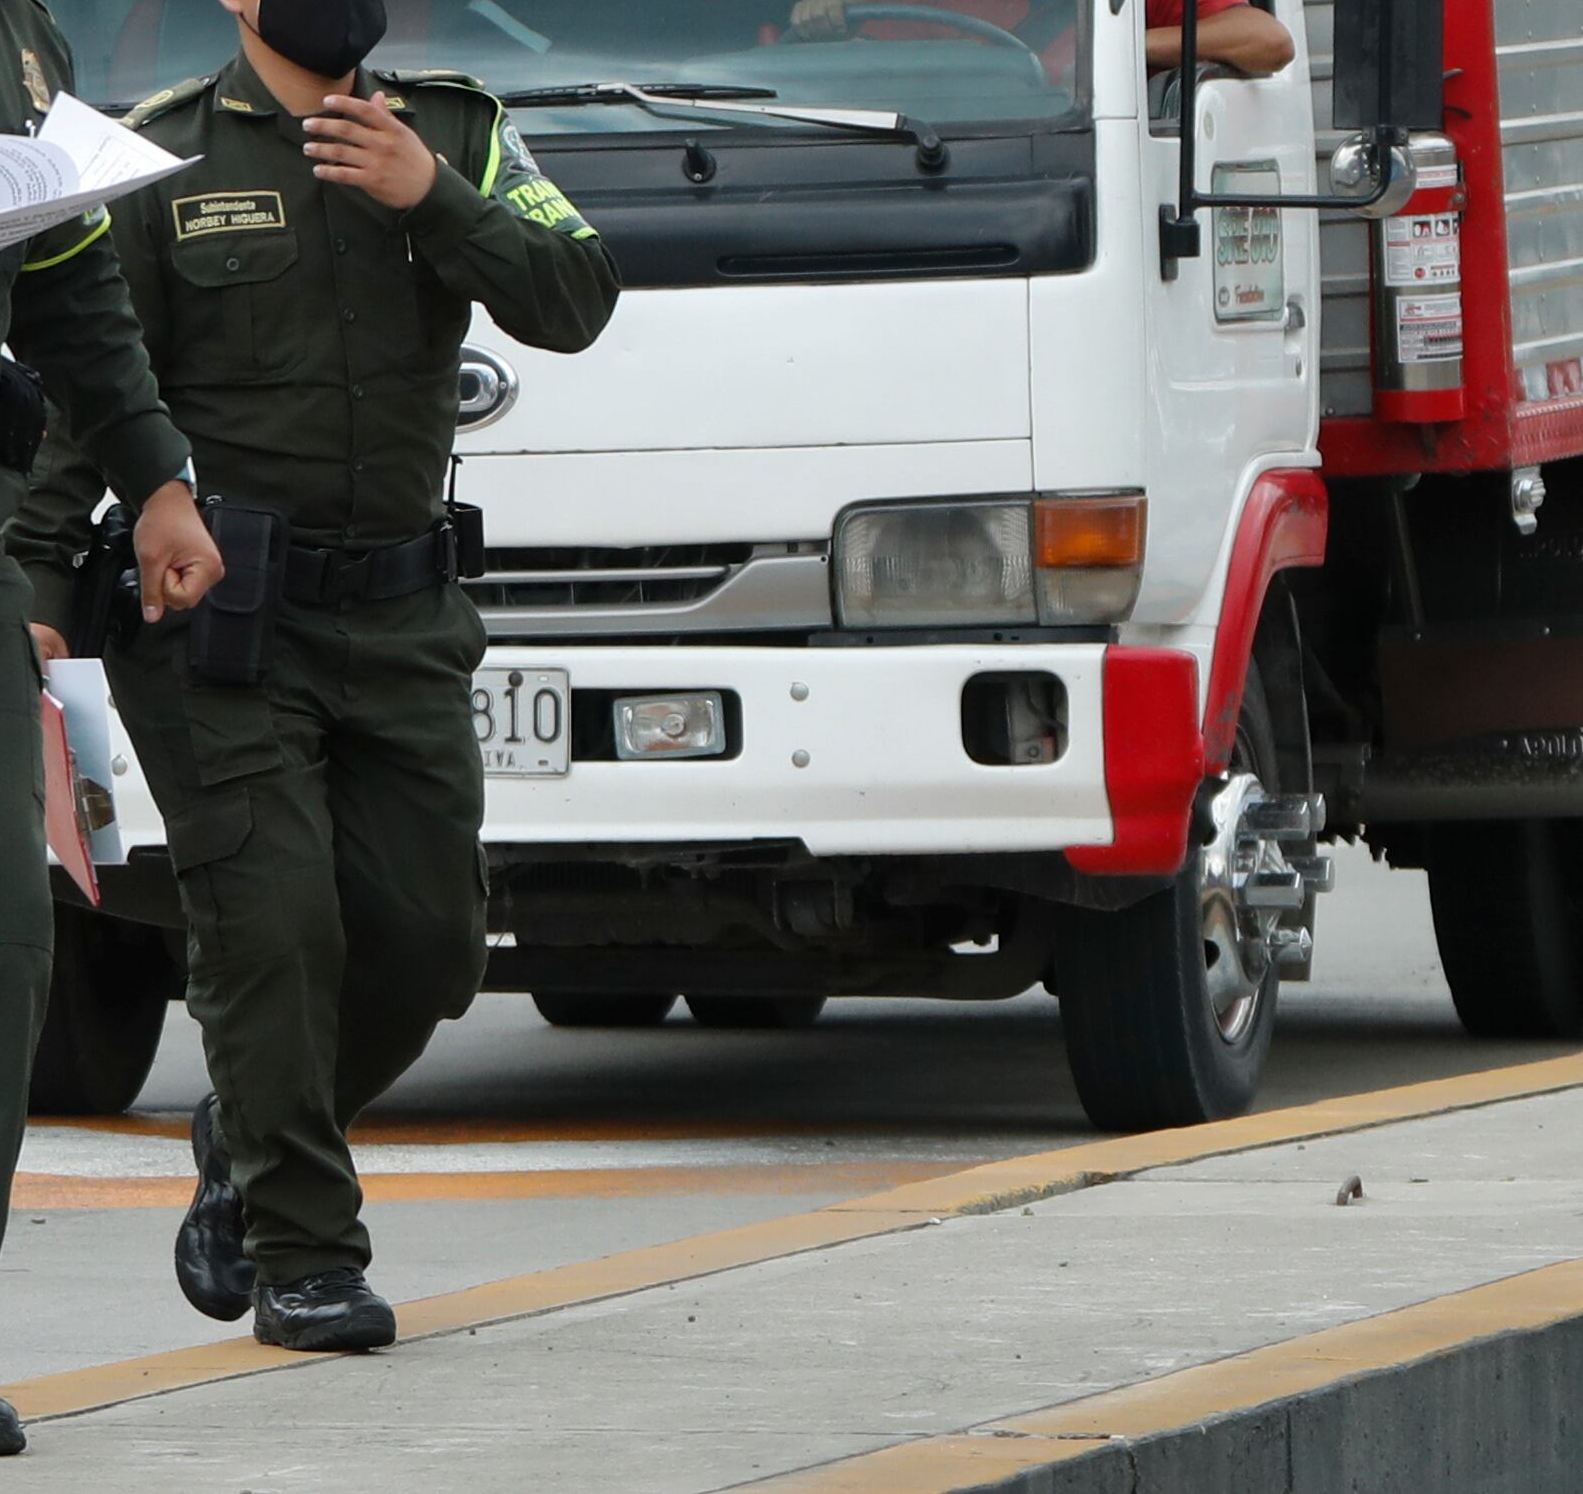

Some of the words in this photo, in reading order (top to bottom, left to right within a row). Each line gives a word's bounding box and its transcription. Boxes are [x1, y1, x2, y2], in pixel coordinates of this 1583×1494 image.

[185, 214, 227, 232] NORBEY
[230, 211, 275, 225] HIGUERA
[471, 687, 562, 743] 810
